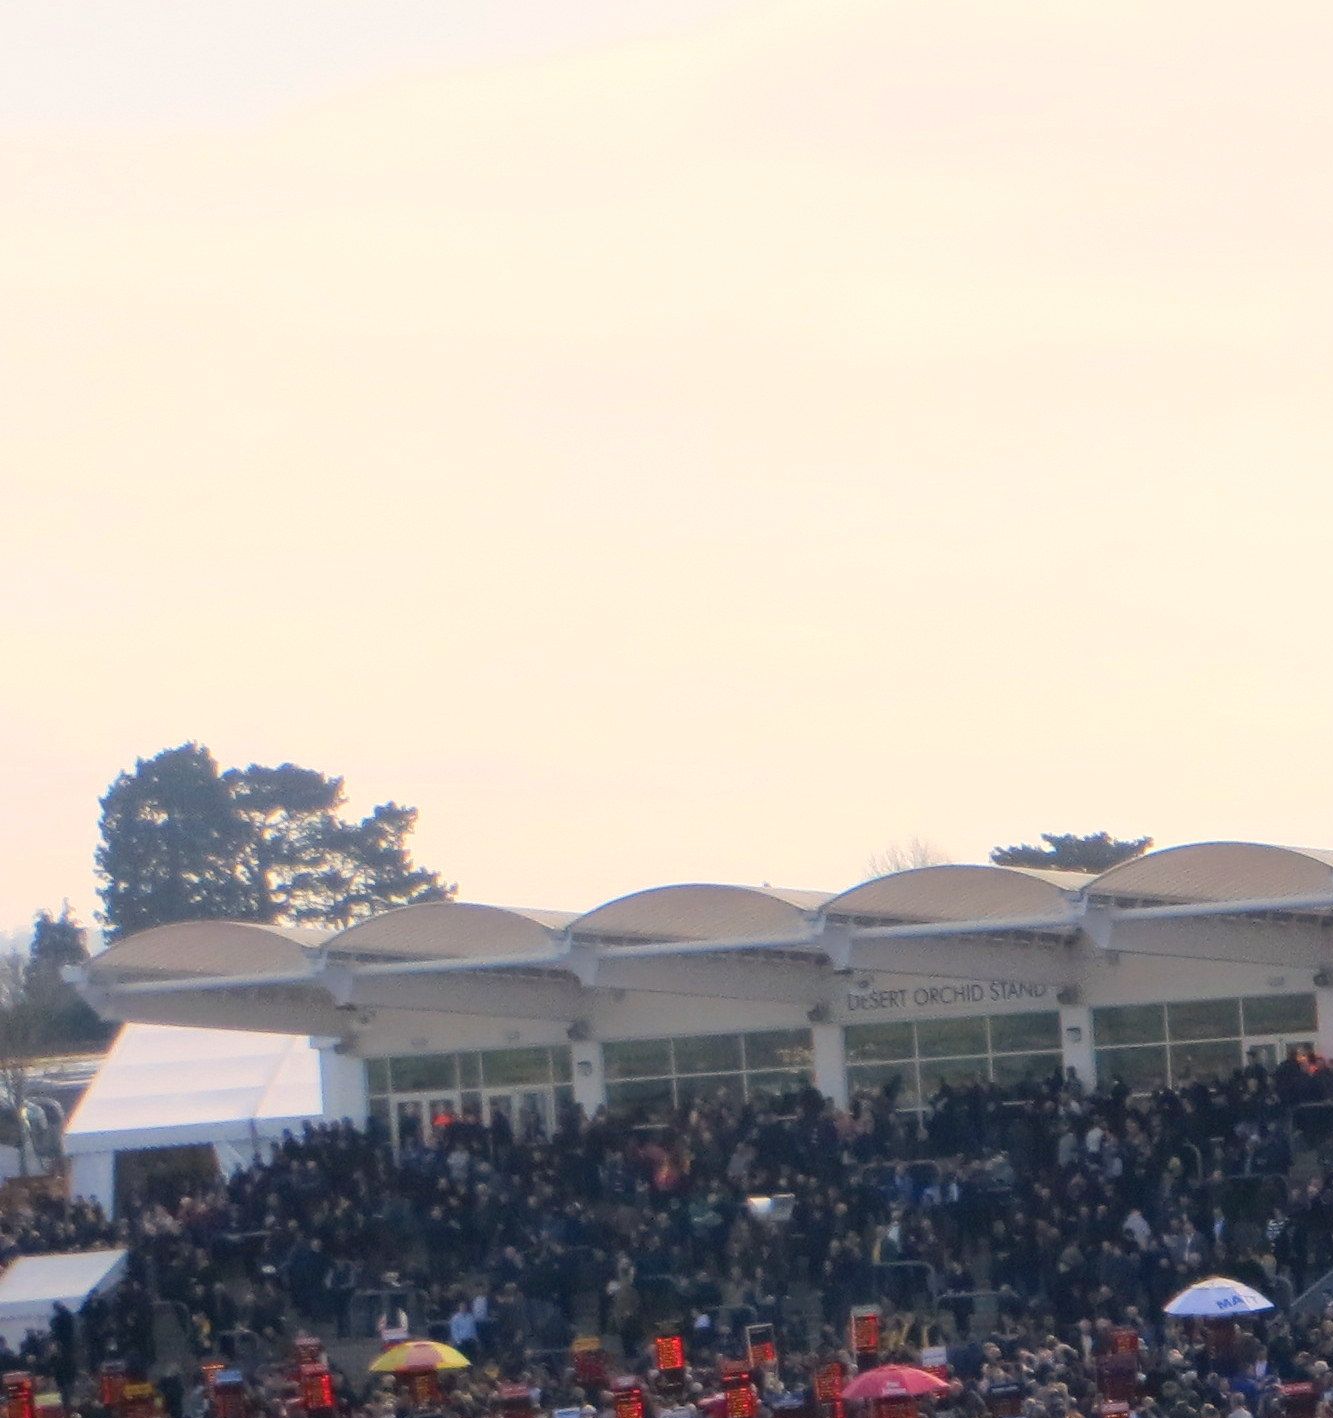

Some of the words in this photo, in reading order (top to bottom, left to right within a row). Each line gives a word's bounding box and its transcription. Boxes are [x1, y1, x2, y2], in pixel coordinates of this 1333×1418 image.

[849, 989, 906, 1011] DESERT
[914, 984, 984, 1007] ORCHID
[990, 979, 1047, 1002] STAND
